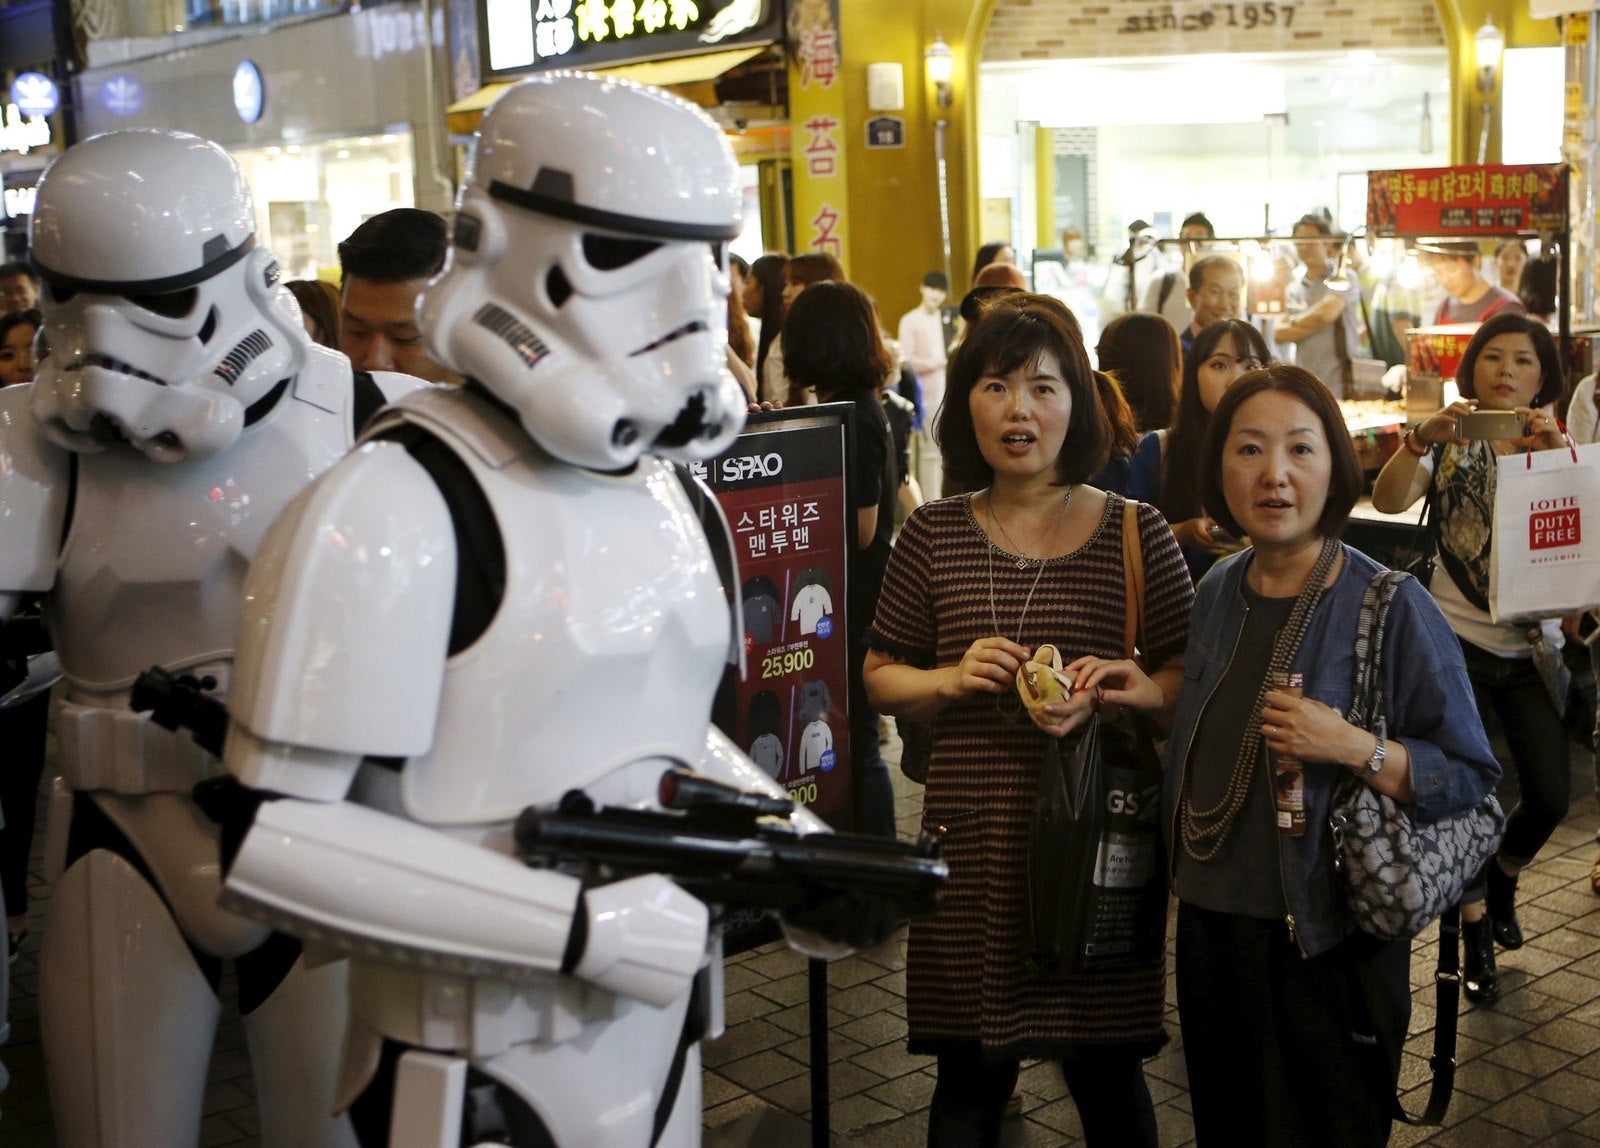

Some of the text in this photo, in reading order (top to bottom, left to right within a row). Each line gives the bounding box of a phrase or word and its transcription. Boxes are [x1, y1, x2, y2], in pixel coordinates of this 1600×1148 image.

[1126, 2, 1296, 33] since 1957
[722, 452, 783, 482] SPAO
[736, 502, 820, 533] 스타워즈
[1530, 495, 1579, 511] LOTTE
[1534, 513, 1576, 531] DUTY
[1535, 527, 1576, 544] FREE
[748, 526, 810, 558] 맨투맨
[1530, 553, 1582, 564] WORLDWIDE
[761, 648, 815, 679] 25,900
